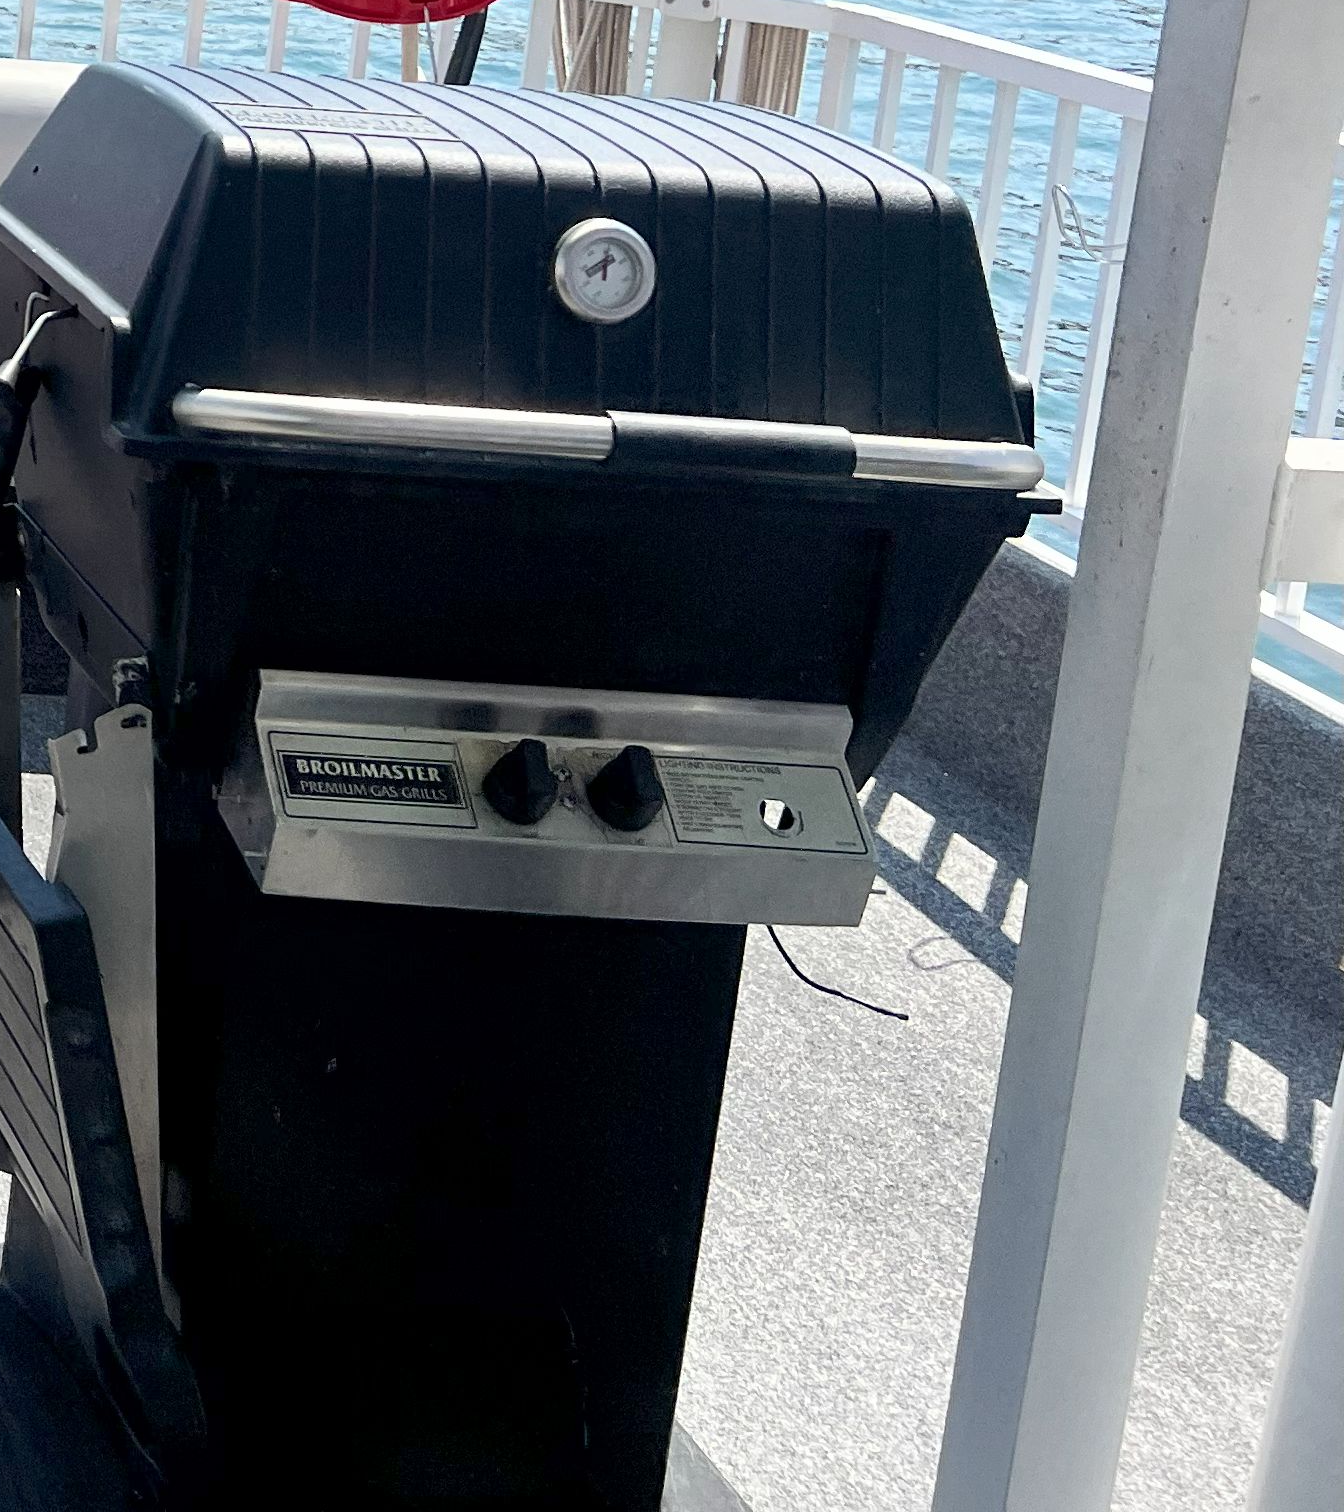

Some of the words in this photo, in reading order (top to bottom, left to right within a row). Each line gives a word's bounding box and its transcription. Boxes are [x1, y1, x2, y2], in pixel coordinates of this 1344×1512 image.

[295, 758, 442, 783] BROILMASTER
[706, 762, 782, 775] INSTRUCTIONS
[300, 780, 368, 796] PREMIUM
[370, 785, 398, 798] GAS
[401, 787, 448, 801] GRILLS
